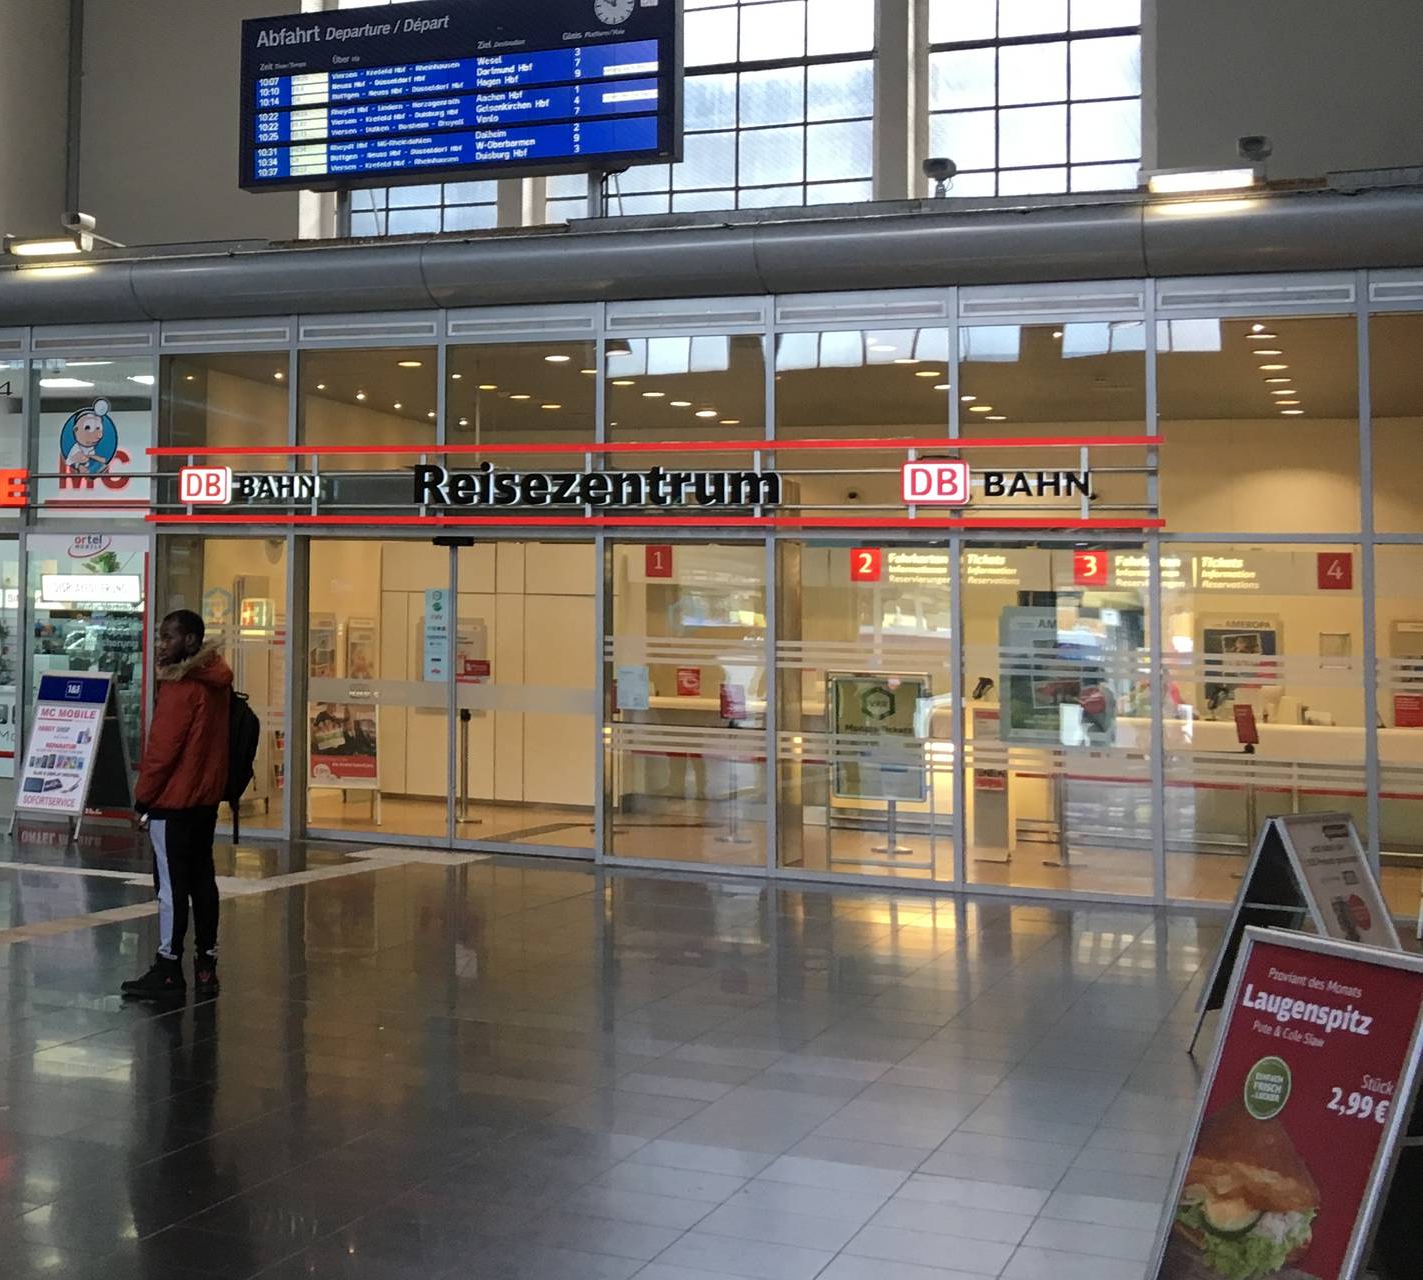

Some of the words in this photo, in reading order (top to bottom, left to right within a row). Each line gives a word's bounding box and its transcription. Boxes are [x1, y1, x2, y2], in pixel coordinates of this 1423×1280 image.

[256, 25, 320, 47] Abfahrt
[325, 22, 390, 41] Departure
[404, 15, 449, 34] Départ
[574, 47, 581, 56] 3
[477, 56, 502, 65] Wesel
[574, 58, 581, 67] 7
[477, 66, 515, 76] Dortmund
[518, 63, 533, 72] Hbf
[574, 69, 581, 78] 9
[259, 77, 279, 87] 10:07
[477, 77, 501, 88] Hagen
[505, 75, 519, 84] Hbf
[259, 88, 280, 96] 10:10
[575, 85, 580, 93] 1
[476, 93, 505, 102] Aachen
[509, 91, 523, 99] Hbf
[573, 96, 580, 104] 4
[259, 98, 279, 106] 10:14
[476, 102, 532, 112] Gelsenkirchen
[535, 99, 550, 107] Hbf
[574, 107, 580, 115] 7
[258, 113, 278, 121] 10:22
[476, 115, 499, 123] Venlo
[258, 123, 278, 131] 10:22
[573, 123, 580, 131] 2
[258, 133, 279, 141] 10:25
[475, 130, 506, 139] Dalheim
[573, 133, 580, 142] 9
[258, 148, 277, 157] 10:31
[573, 144, 580, 153] 3
[475, 151, 510, 161] Duisburg
[513, 149, 528, 157] Hbf
[258, 159, 277, 167] 10:34
[258, 168, 278, 177] 10:37
[186, 473, 221, 497] DB
[239, 475, 319, 498] BAHN
[413, 462, 782, 505] Reisezentrum
[910, 468, 958, 496] DB
[984, 471, 1090, 497] BAHN
[75, 535, 102, 544] ortel
[653, 552, 664, 570] 1
[858, 553, 872, 573] 2
[967, 554, 1006, 565] Tickets
[1201, 556, 1244, 568] Tickets
[1083, 556, 1097, 577] 3
[1327, 560, 1343, 579] 4
[1201, 570, 1256, 579] Information
[41, 708, 56, 717] MC
[58, 709, 97, 719] MOBILE
[1268, 967, 1307, 985] Proviant
[1308, 977, 1325, 990] des
[1327, 980, 1362, 998] Monats
[1242, 983, 1374, 1035] Laugenspitz
[1282, 1027, 1303, 1042] Cole
[1301, 1032, 1325, 1048] Slaw
[1253, 1081, 1282, 1094] FRISCH
[1361, 1074, 1394, 1096] Stück
[1327, 1087, 1373, 1119] 2,99
[1374, 1099, 1390, 1124] €
